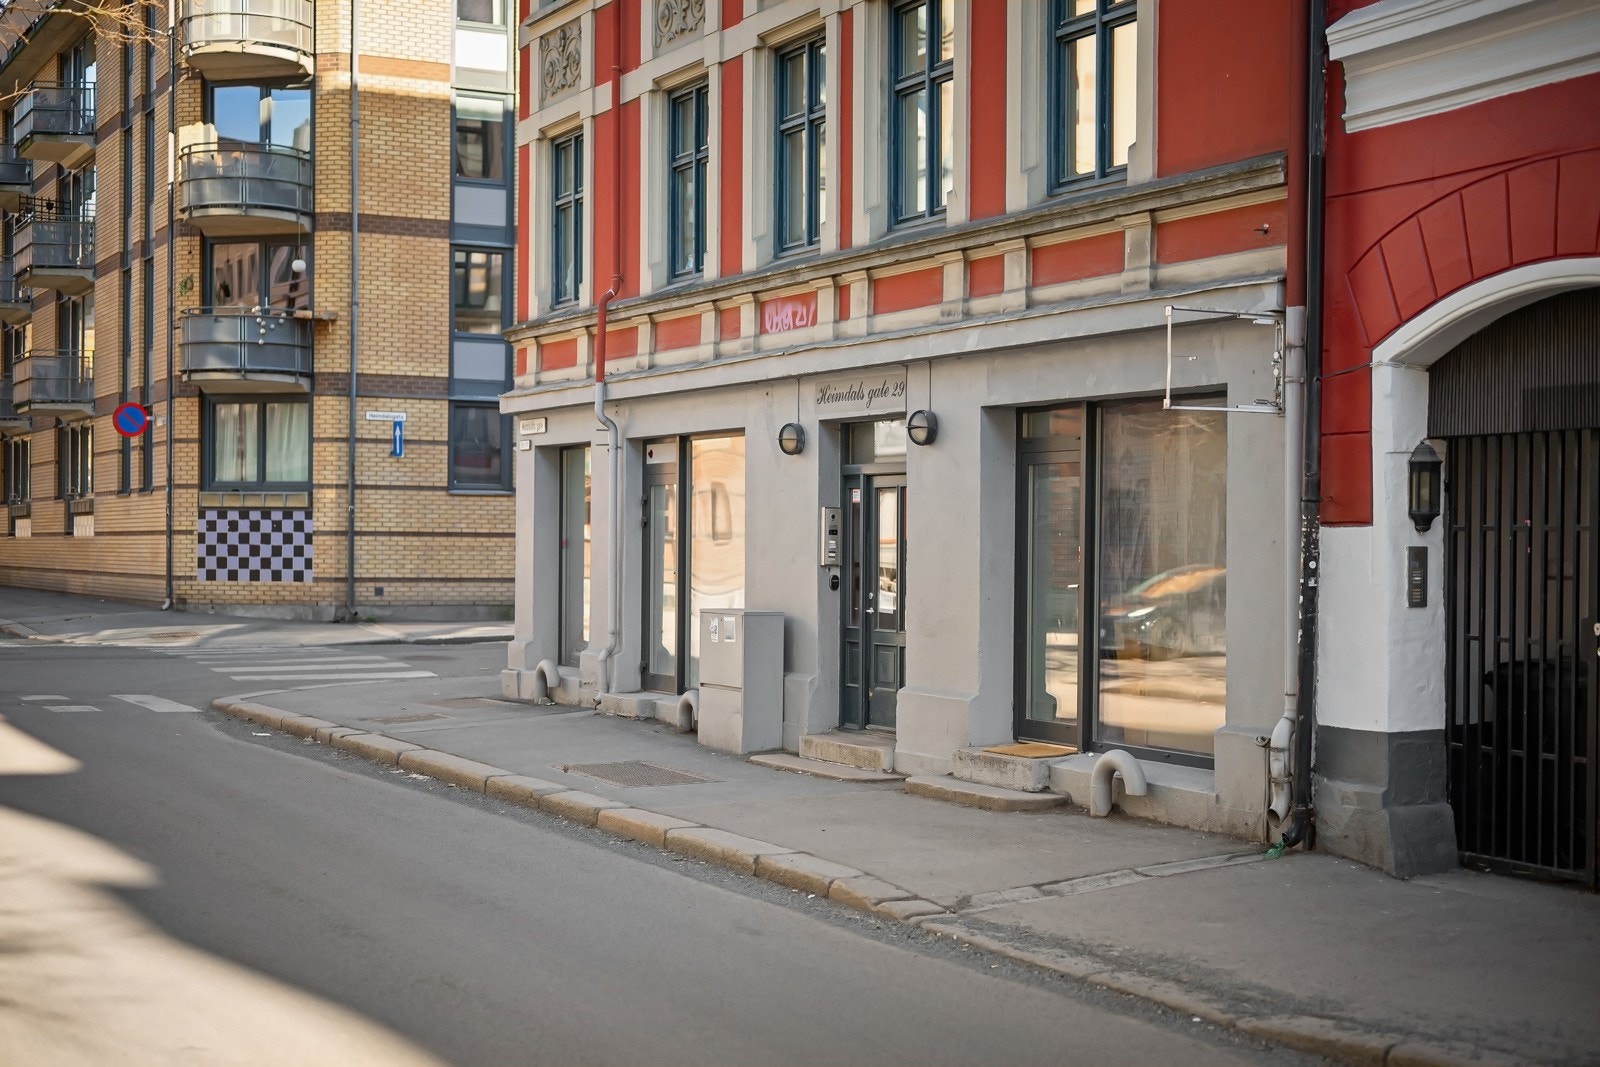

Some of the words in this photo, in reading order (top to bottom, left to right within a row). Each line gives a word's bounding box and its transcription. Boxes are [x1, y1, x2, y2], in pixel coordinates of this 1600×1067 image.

[816, 381, 865, 405] Heimdals
[866, 380, 890, 409] gate
[891, 381, 905, 397] 29
